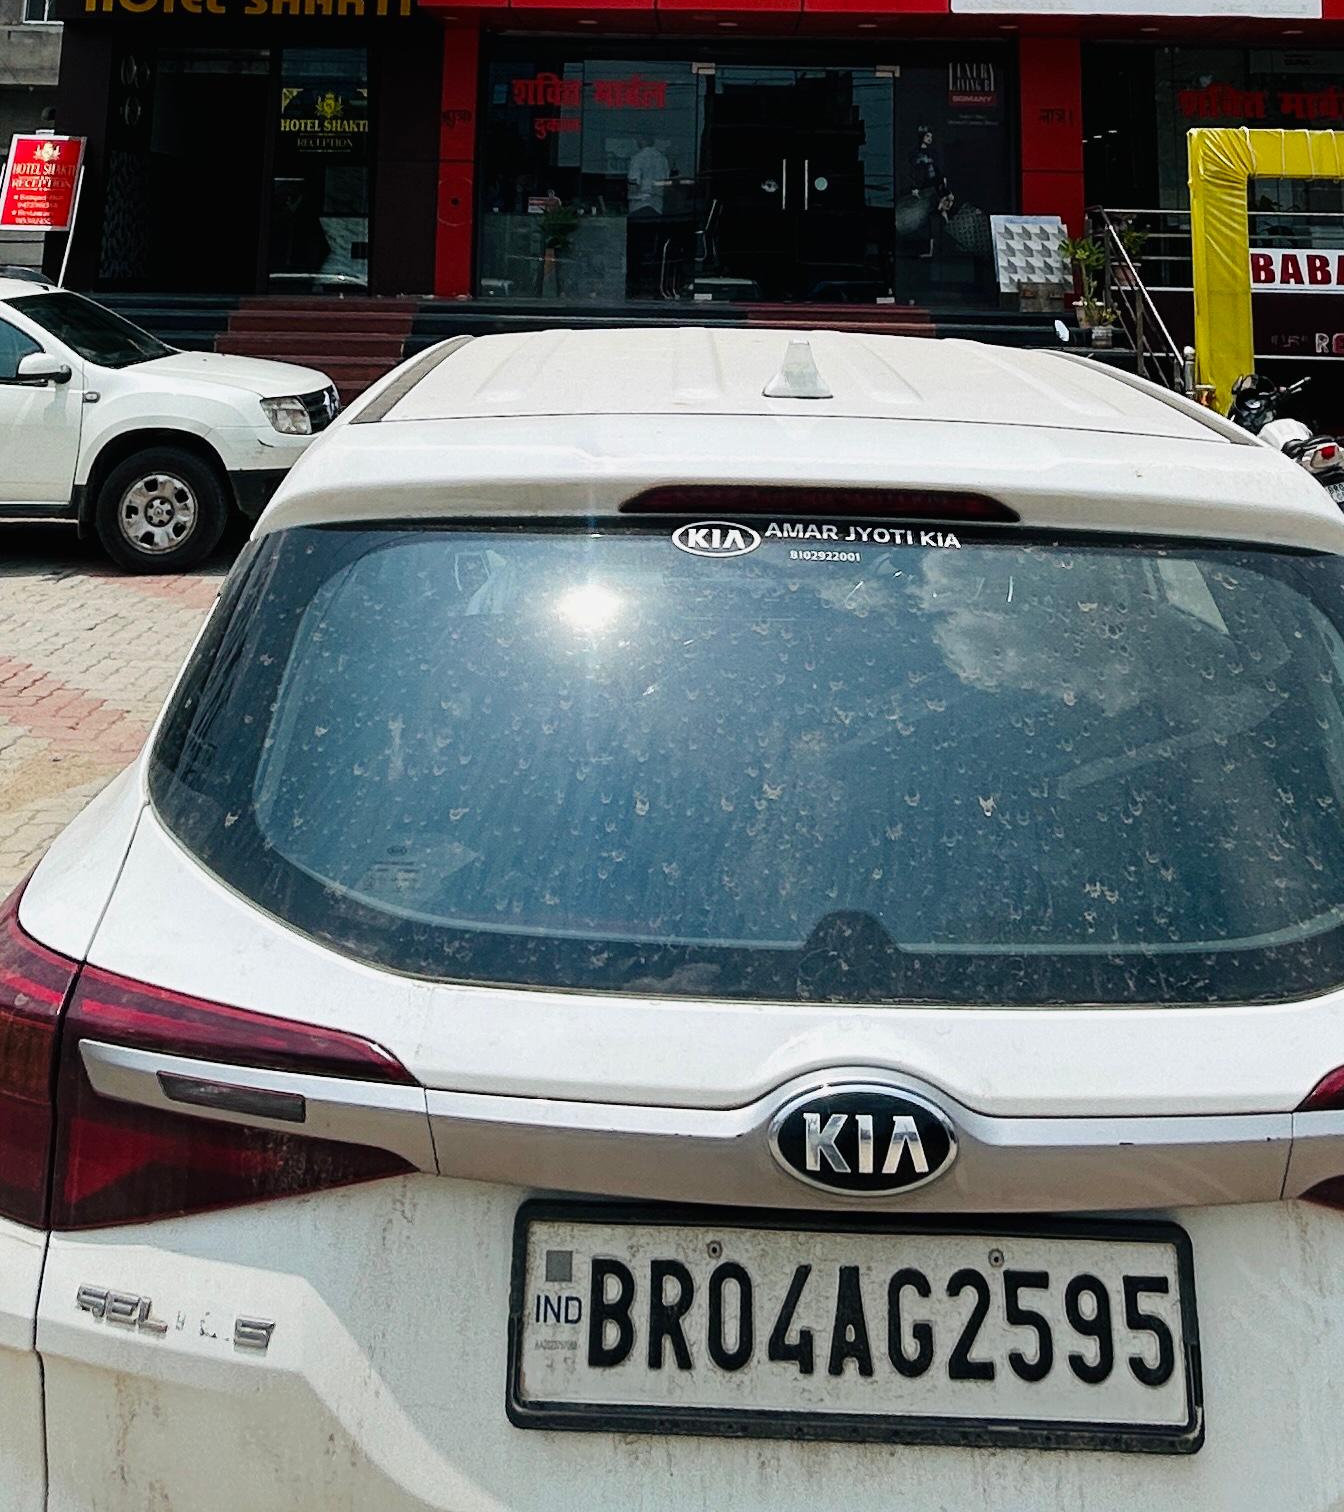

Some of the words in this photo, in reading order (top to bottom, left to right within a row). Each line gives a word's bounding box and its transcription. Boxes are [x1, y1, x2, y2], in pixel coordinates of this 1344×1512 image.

[281, 119, 321, 131] HOTEL
[324, 120, 368, 133] SHAKTI
[13, 162, 42, 176] HOTEL
[765, 522, 838, 540] AMAR
[845, 526, 913, 546] JYOTI
[920, 531, 962, 549] KIA
[803, 1113, 930, 1174] KIA
[536, 1293, 582, 1324] IND
[588, 1257, 1175, 1387] BR04AG2595
